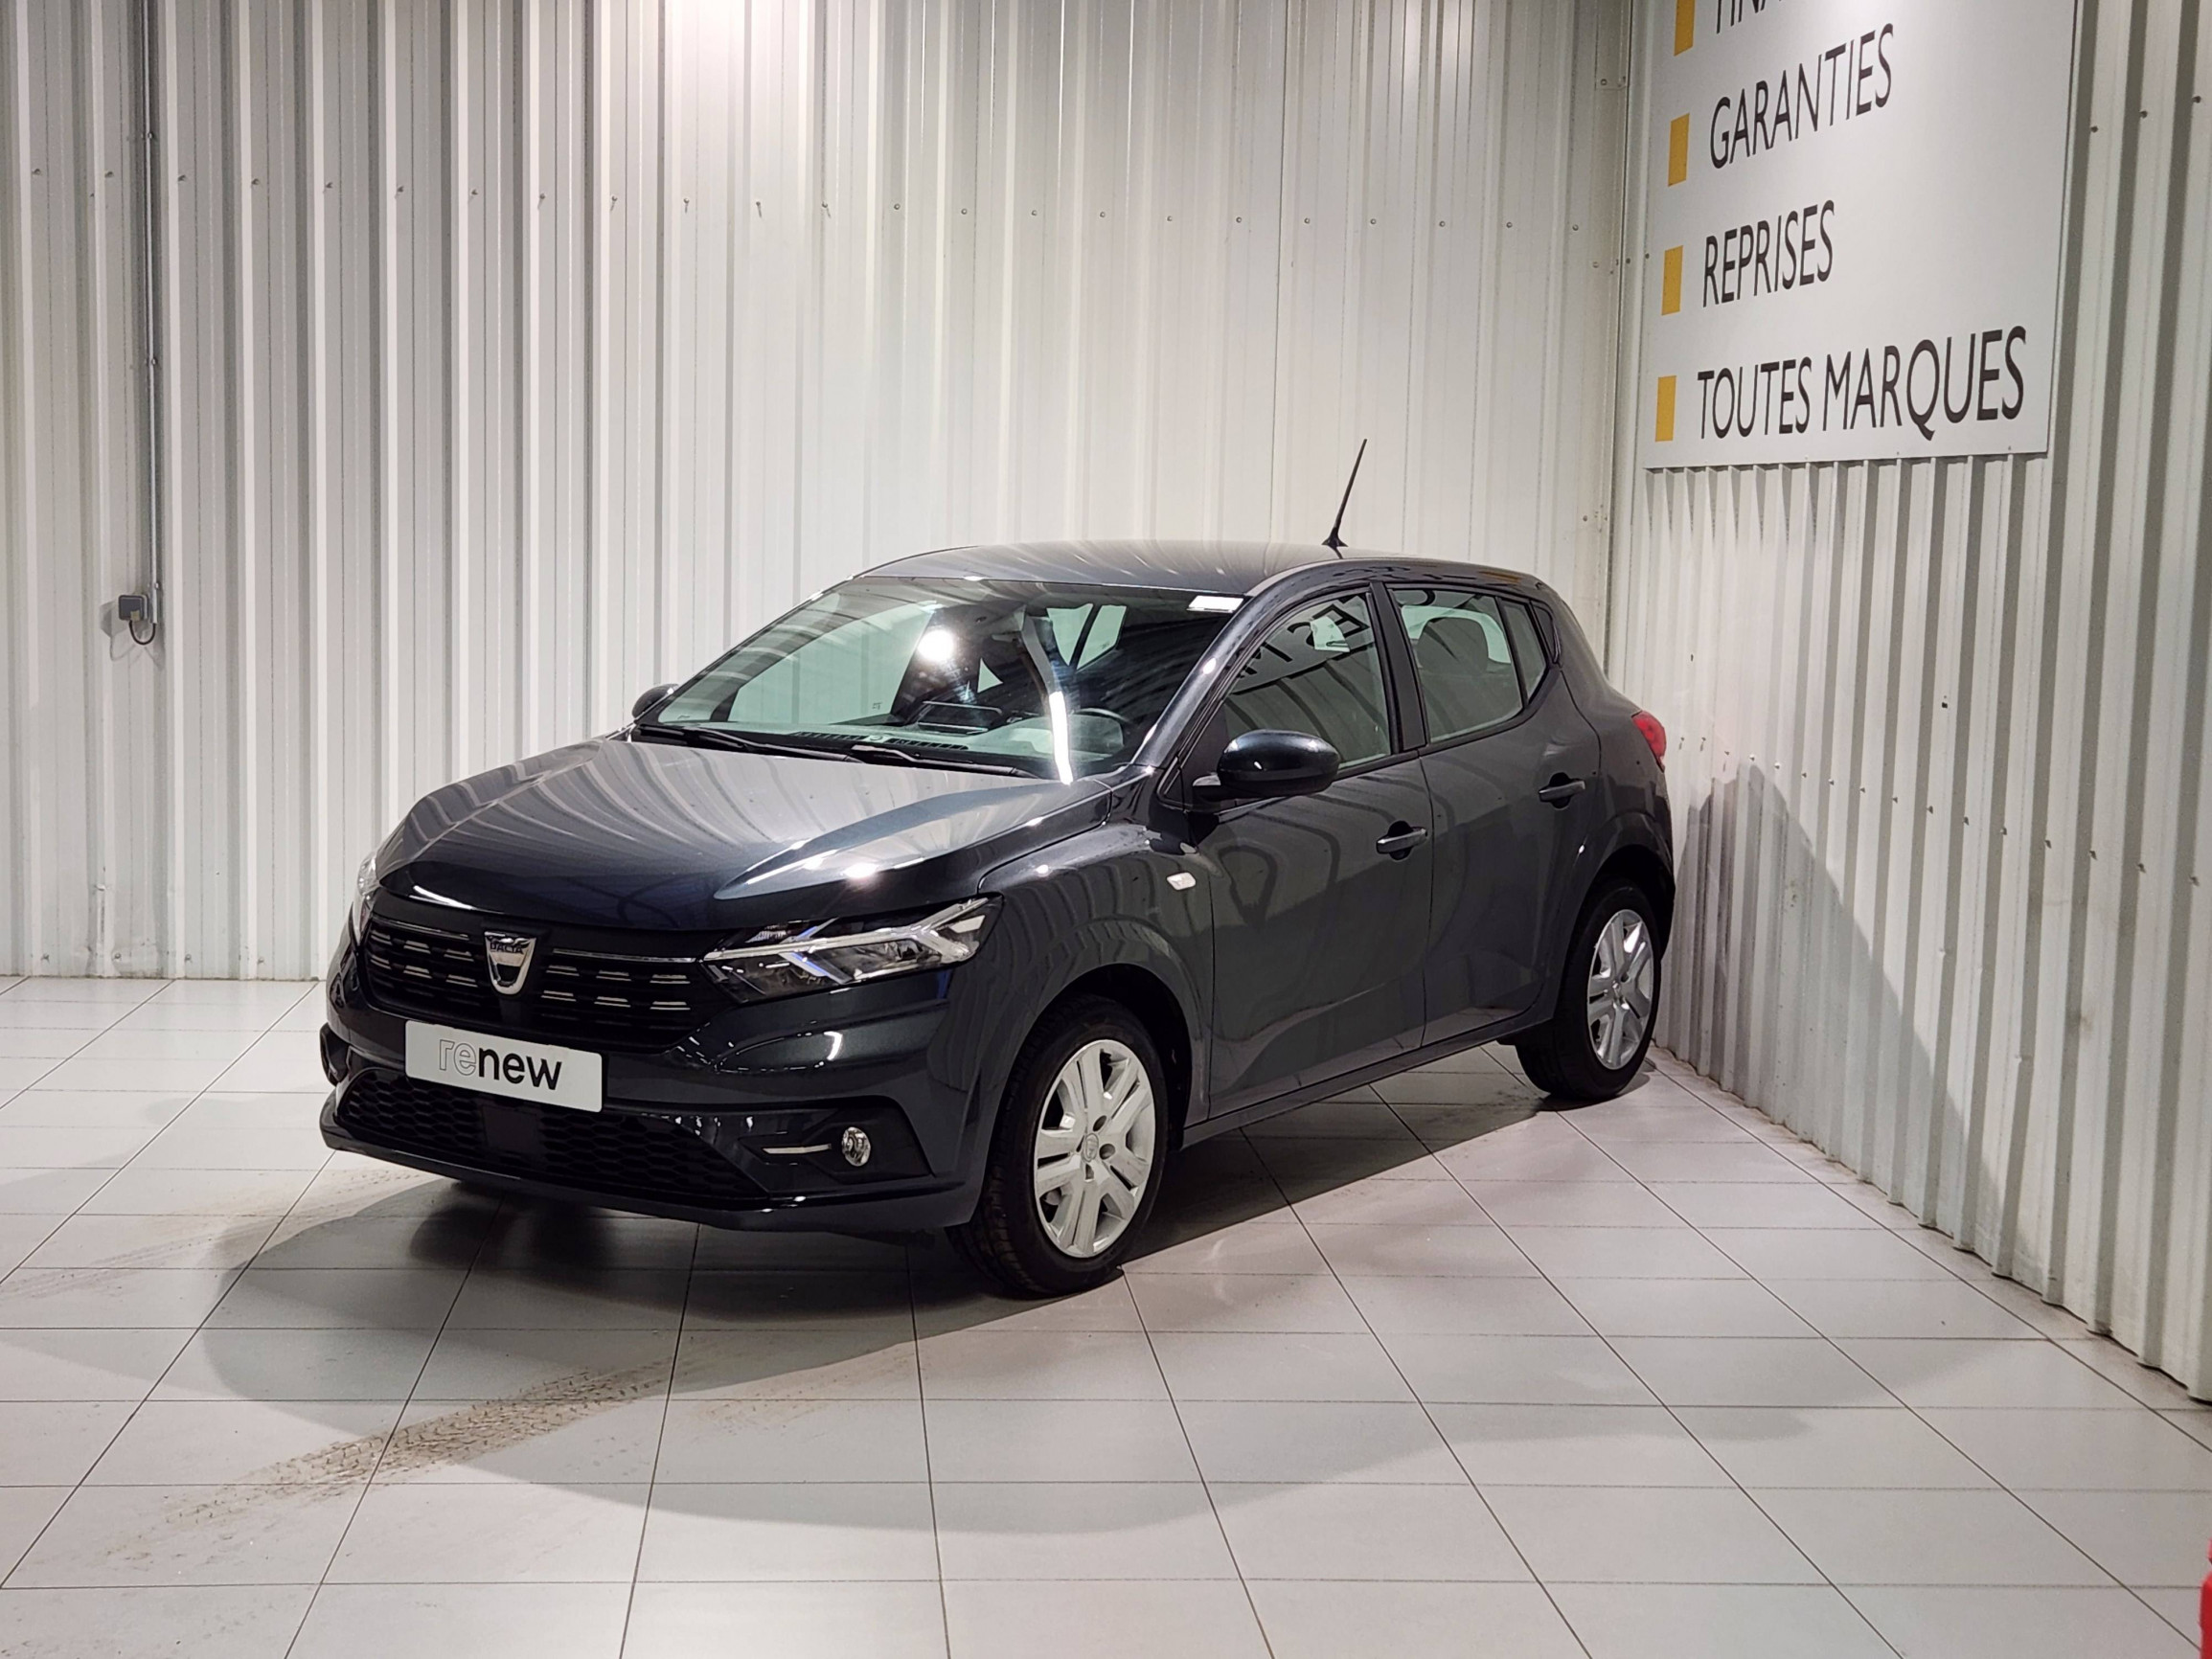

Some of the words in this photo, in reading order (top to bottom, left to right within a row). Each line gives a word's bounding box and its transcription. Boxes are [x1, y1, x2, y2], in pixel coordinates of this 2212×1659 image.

[1709, 22, 1895, 170] GARANTIES
[1702, 199, 1836, 307] REPRISES
[1697, 355, 1813, 440] TOUTES
[1822, 326, 2027, 442] MARQUES
[439, 1039, 561, 1090] renew
